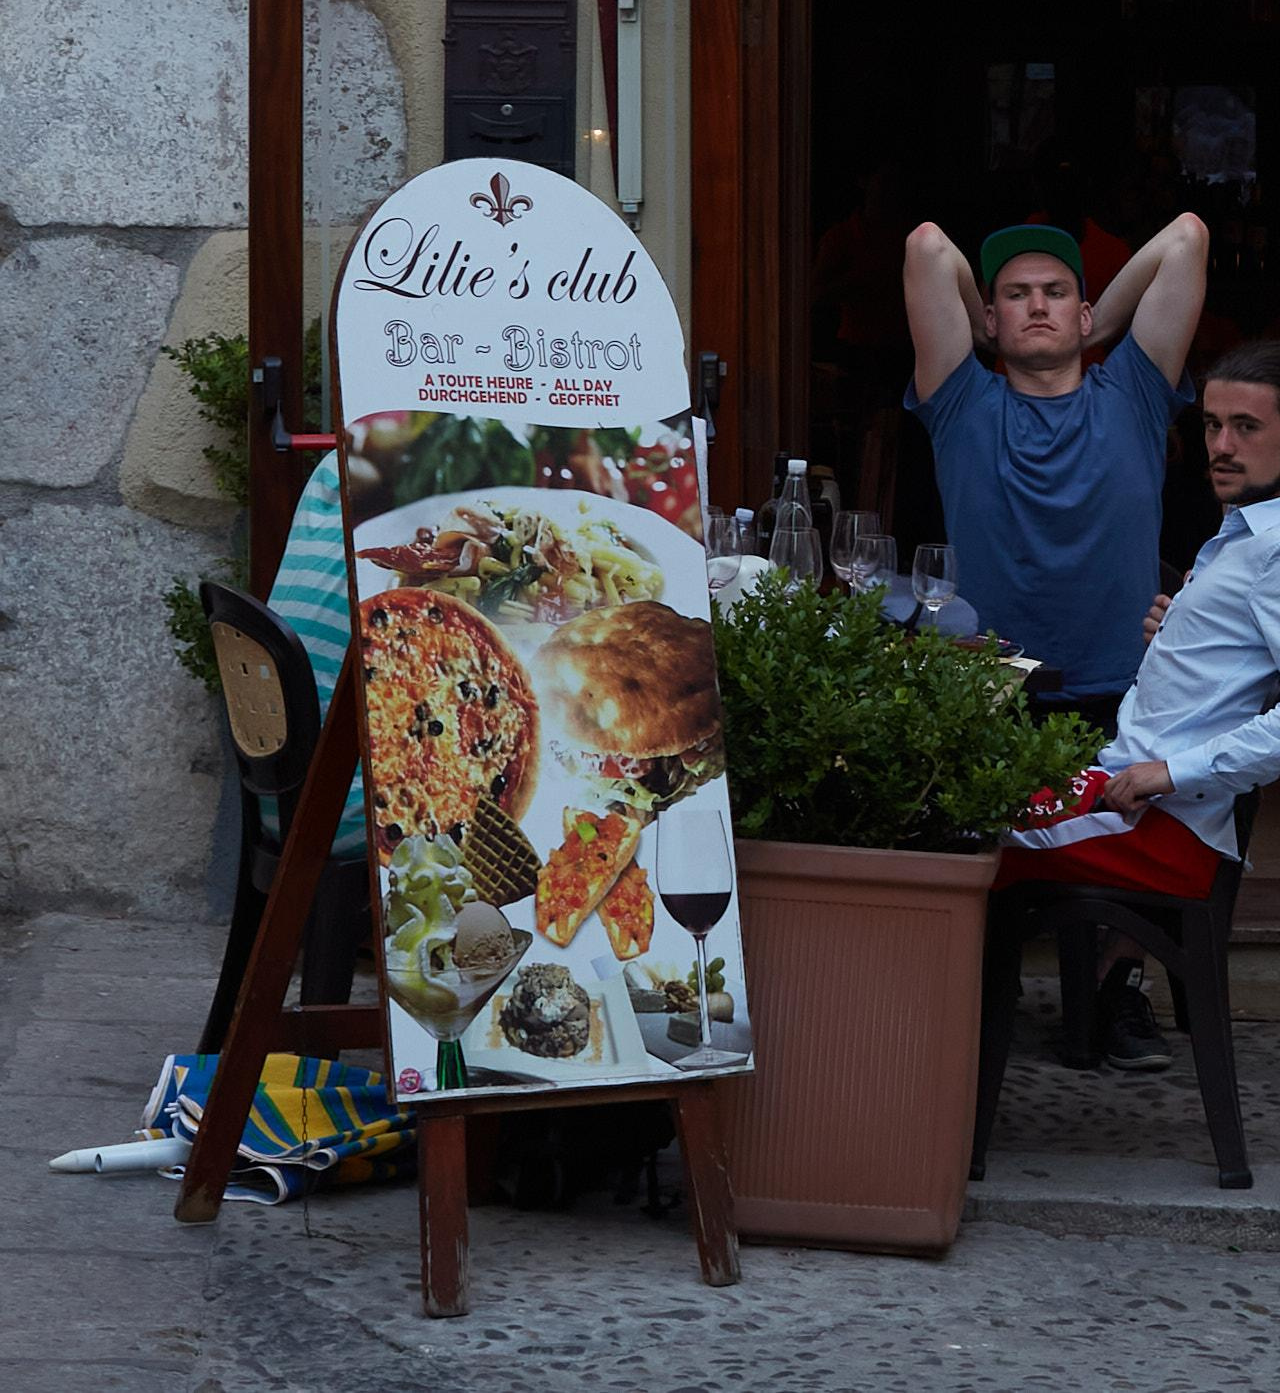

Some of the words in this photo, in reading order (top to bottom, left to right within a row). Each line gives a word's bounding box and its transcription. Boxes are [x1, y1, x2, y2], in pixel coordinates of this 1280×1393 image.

[353, 217, 530, 299] Lilie's
[547, 247, 637, 304] club
[384, 319, 464, 368] Bar
[501, 324, 642, 372] Bistrot
[418, 388, 528, 404] DURCHGEHEND
[548, 392, 620, 407] GEOFFNET
[424, 374, 434, 387] A
[438, 374, 483, 389] TOUTE
[486, 376, 533, 390] HEURE
[554, 378, 580, 391] ALL
[584, 379, 613, 393] DAY
